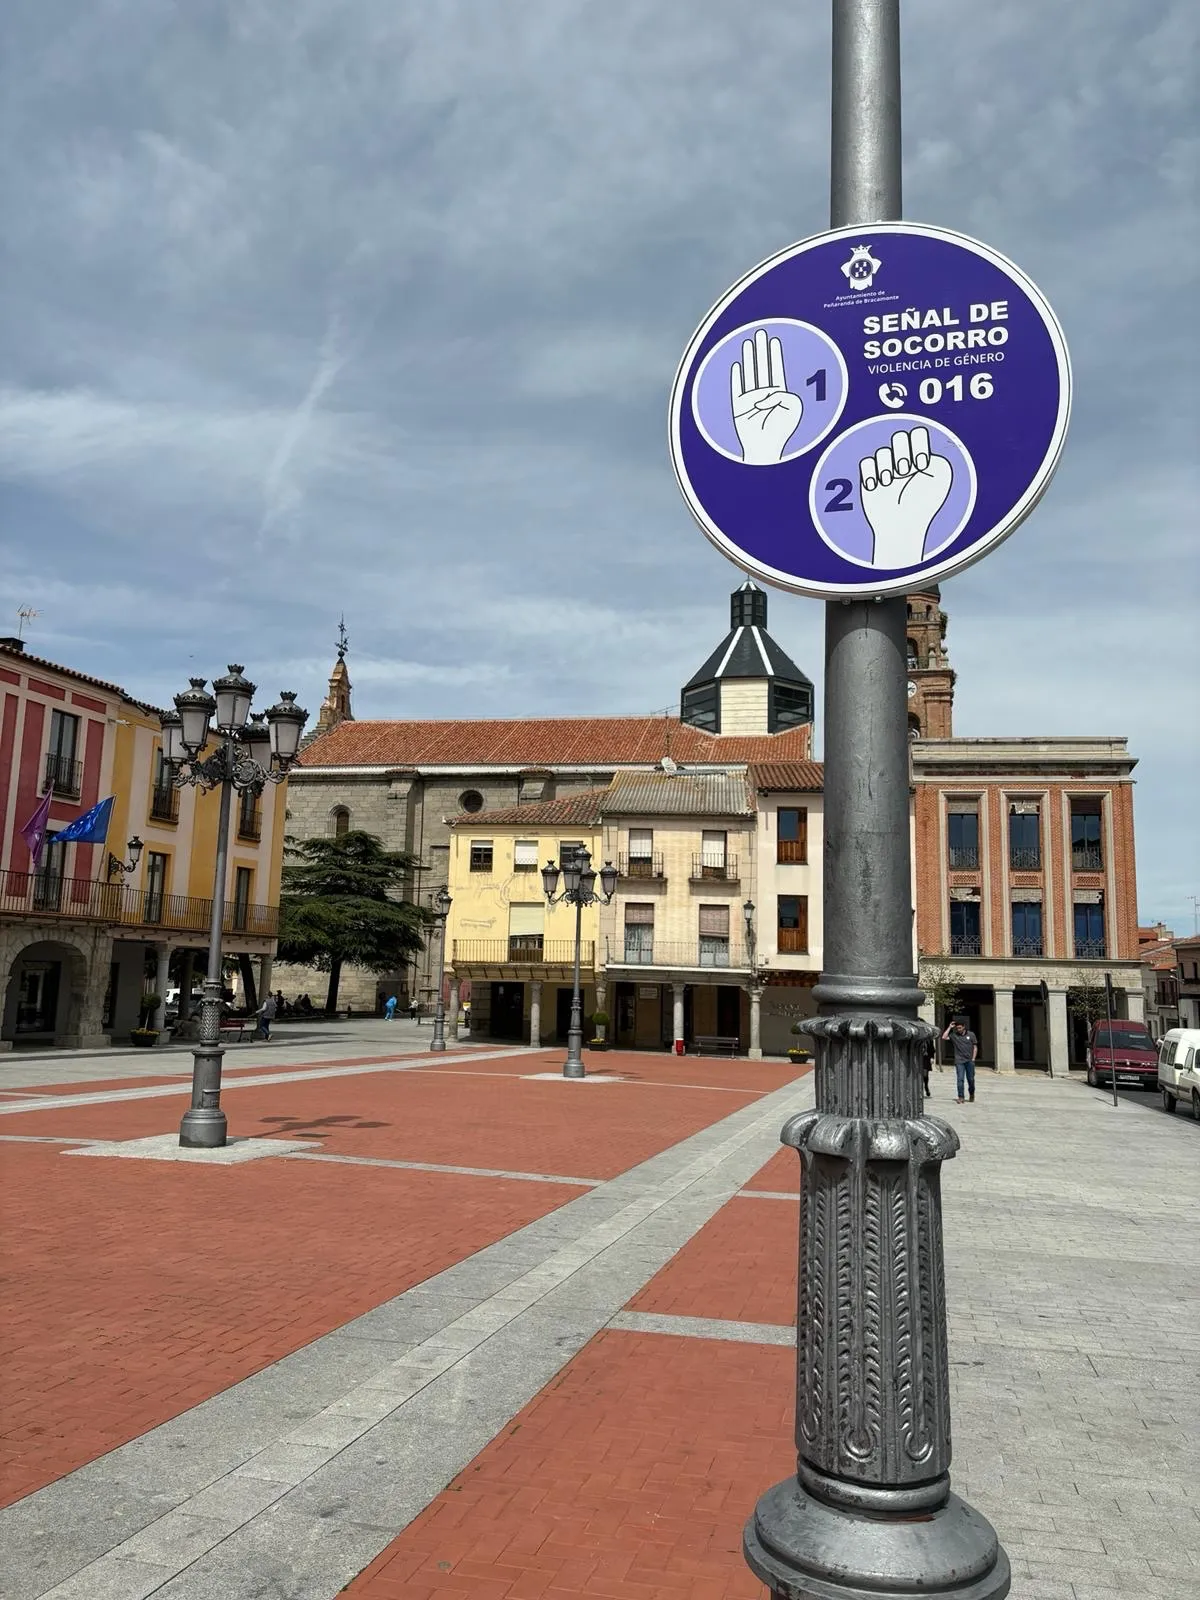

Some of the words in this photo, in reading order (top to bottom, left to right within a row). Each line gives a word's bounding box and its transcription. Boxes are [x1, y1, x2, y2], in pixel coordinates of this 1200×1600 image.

[823, 299, 854, 308] Peñaranda
[863, 295, 899, 304] Bracamonte
[835, 291, 877, 301] Ayuntamiento
[863, 307, 959, 335] SEÑAL
[969, 301, 1009, 323] DE
[863, 326, 1009, 359] SOCORRO
[868, 359, 931, 375] VIOLENCIA
[935, 357, 950, 368] DE
[953, 351, 1005, 366] GÉNERO
[806, 369, 826, 401] 1
[919, 372, 994, 405] 016
[824, 478, 853, 513] 2
